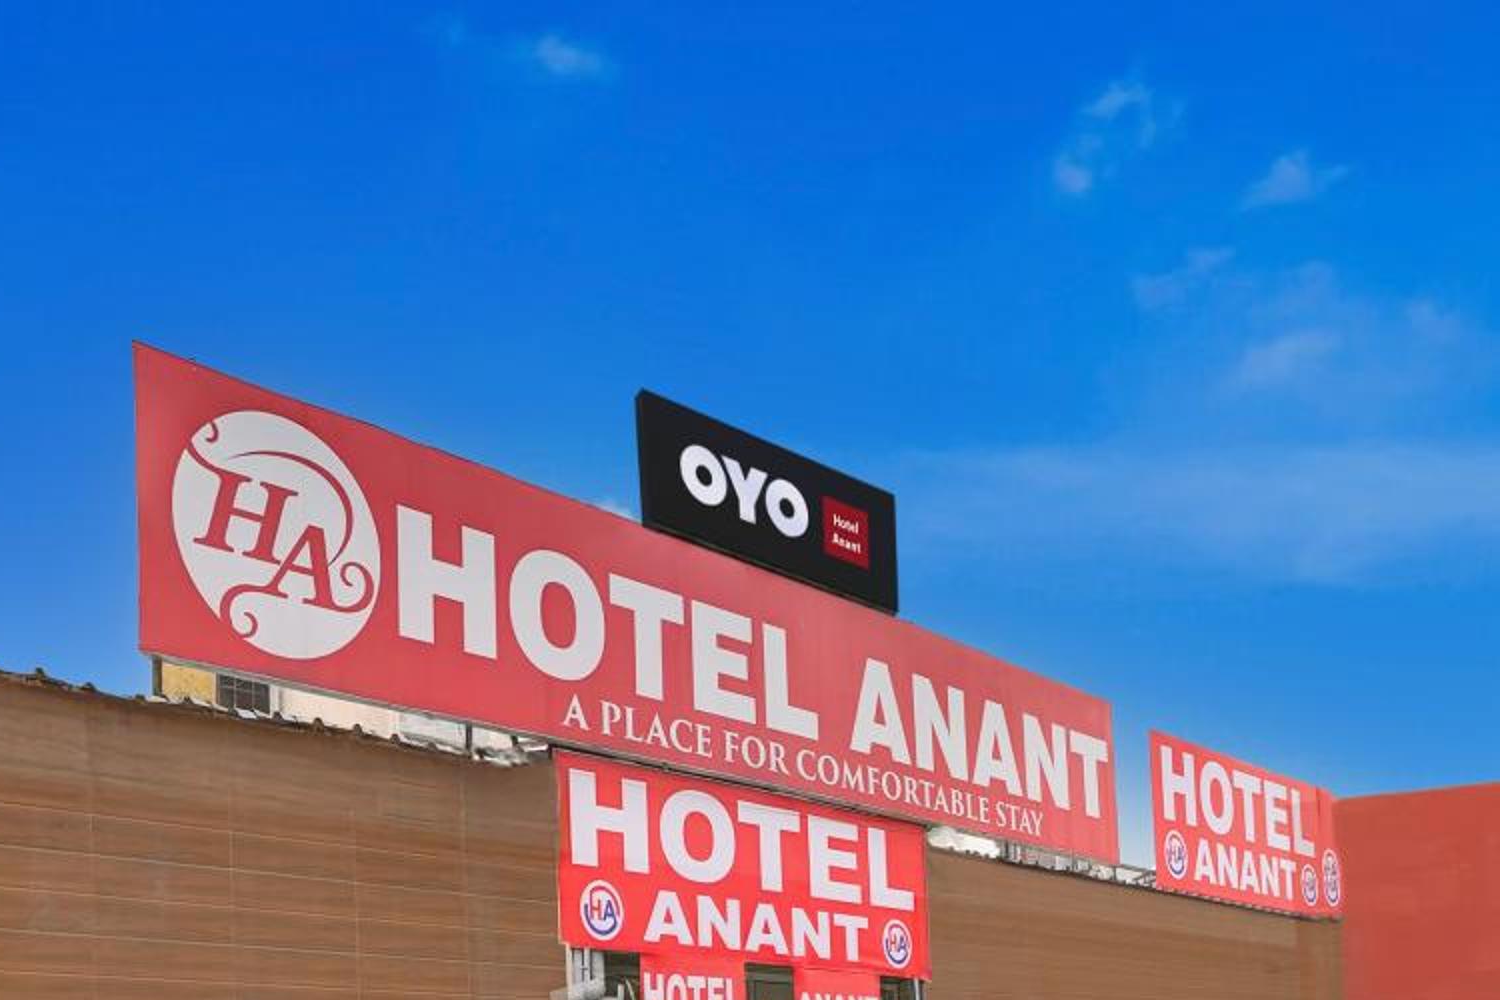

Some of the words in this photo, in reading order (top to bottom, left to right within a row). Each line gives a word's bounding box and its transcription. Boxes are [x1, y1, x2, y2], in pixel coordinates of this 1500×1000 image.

[679, 444, 809, 537] OYO
[833, 513, 859, 534] Hotel
[831, 532, 861, 554] Anant
[396, 503, 819, 741] HOTEL
[850, 657, 1109, 819] ANANT
[563, 693, 590, 731] A
[600, 699, 713, 758] PLACE
[723, 729, 789, 775] FOR
[796, 749, 990, 824] COMFORTABLE
[996, 800, 1044, 837] STAY
[1160, 744, 1316, 858] HOTEL
[568, 767, 915, 911] HOTEL
[1195, 837, 1297, 900] ANANT
[643, 890, 869, 962] ANANT
